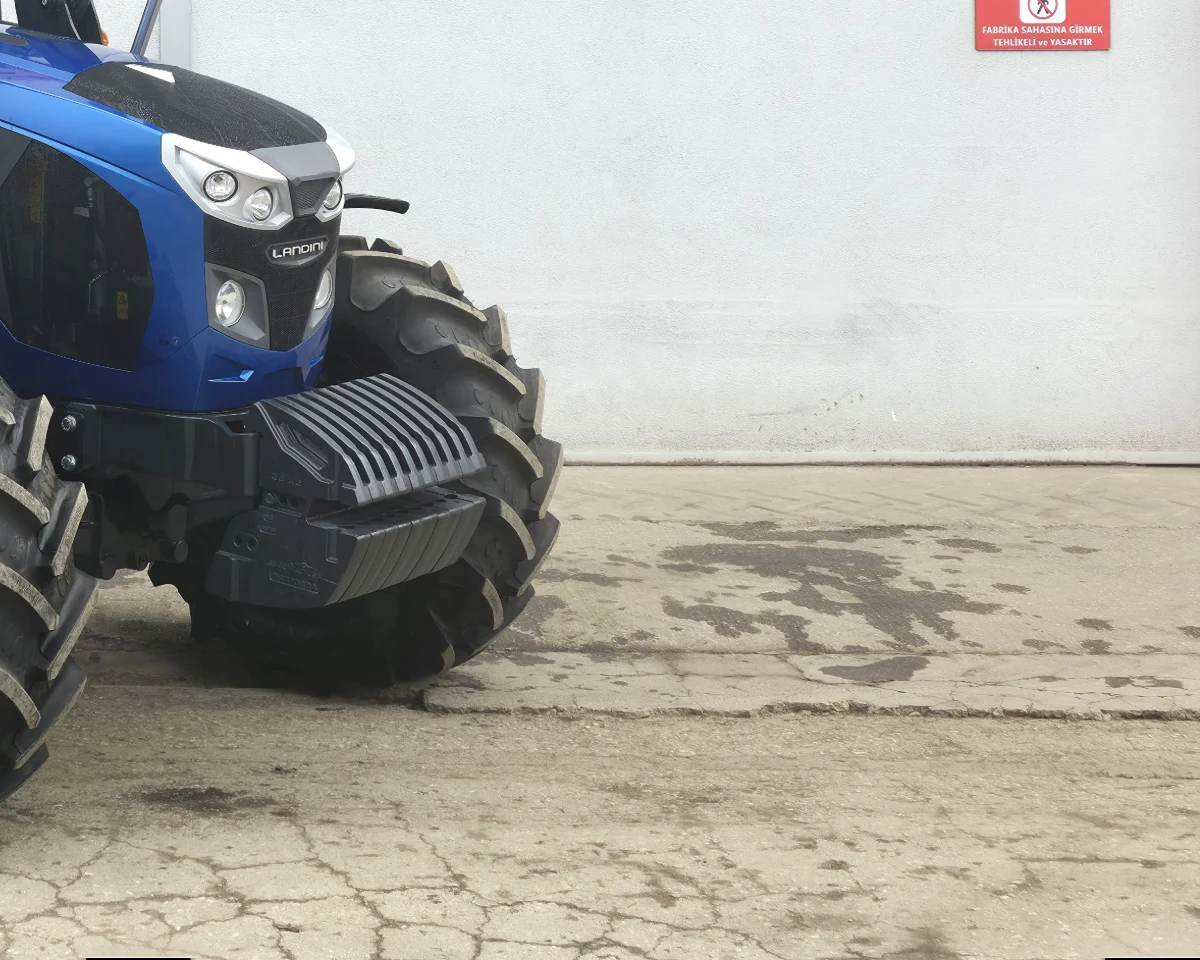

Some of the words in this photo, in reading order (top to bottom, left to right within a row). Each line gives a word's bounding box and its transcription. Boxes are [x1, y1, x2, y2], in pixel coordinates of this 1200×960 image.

[982, 24, 1019, 34] FABRİKA
[1021, 26, 1067, 34] SAHASINA
[1069, 24, 1103, 34] GİRMEK
[993, 36, 1036, 47] TEHLİKELİ
[1050, 38, 1092, 46] YASAKTIR
[272, 241, 324, 259] LANDINI
